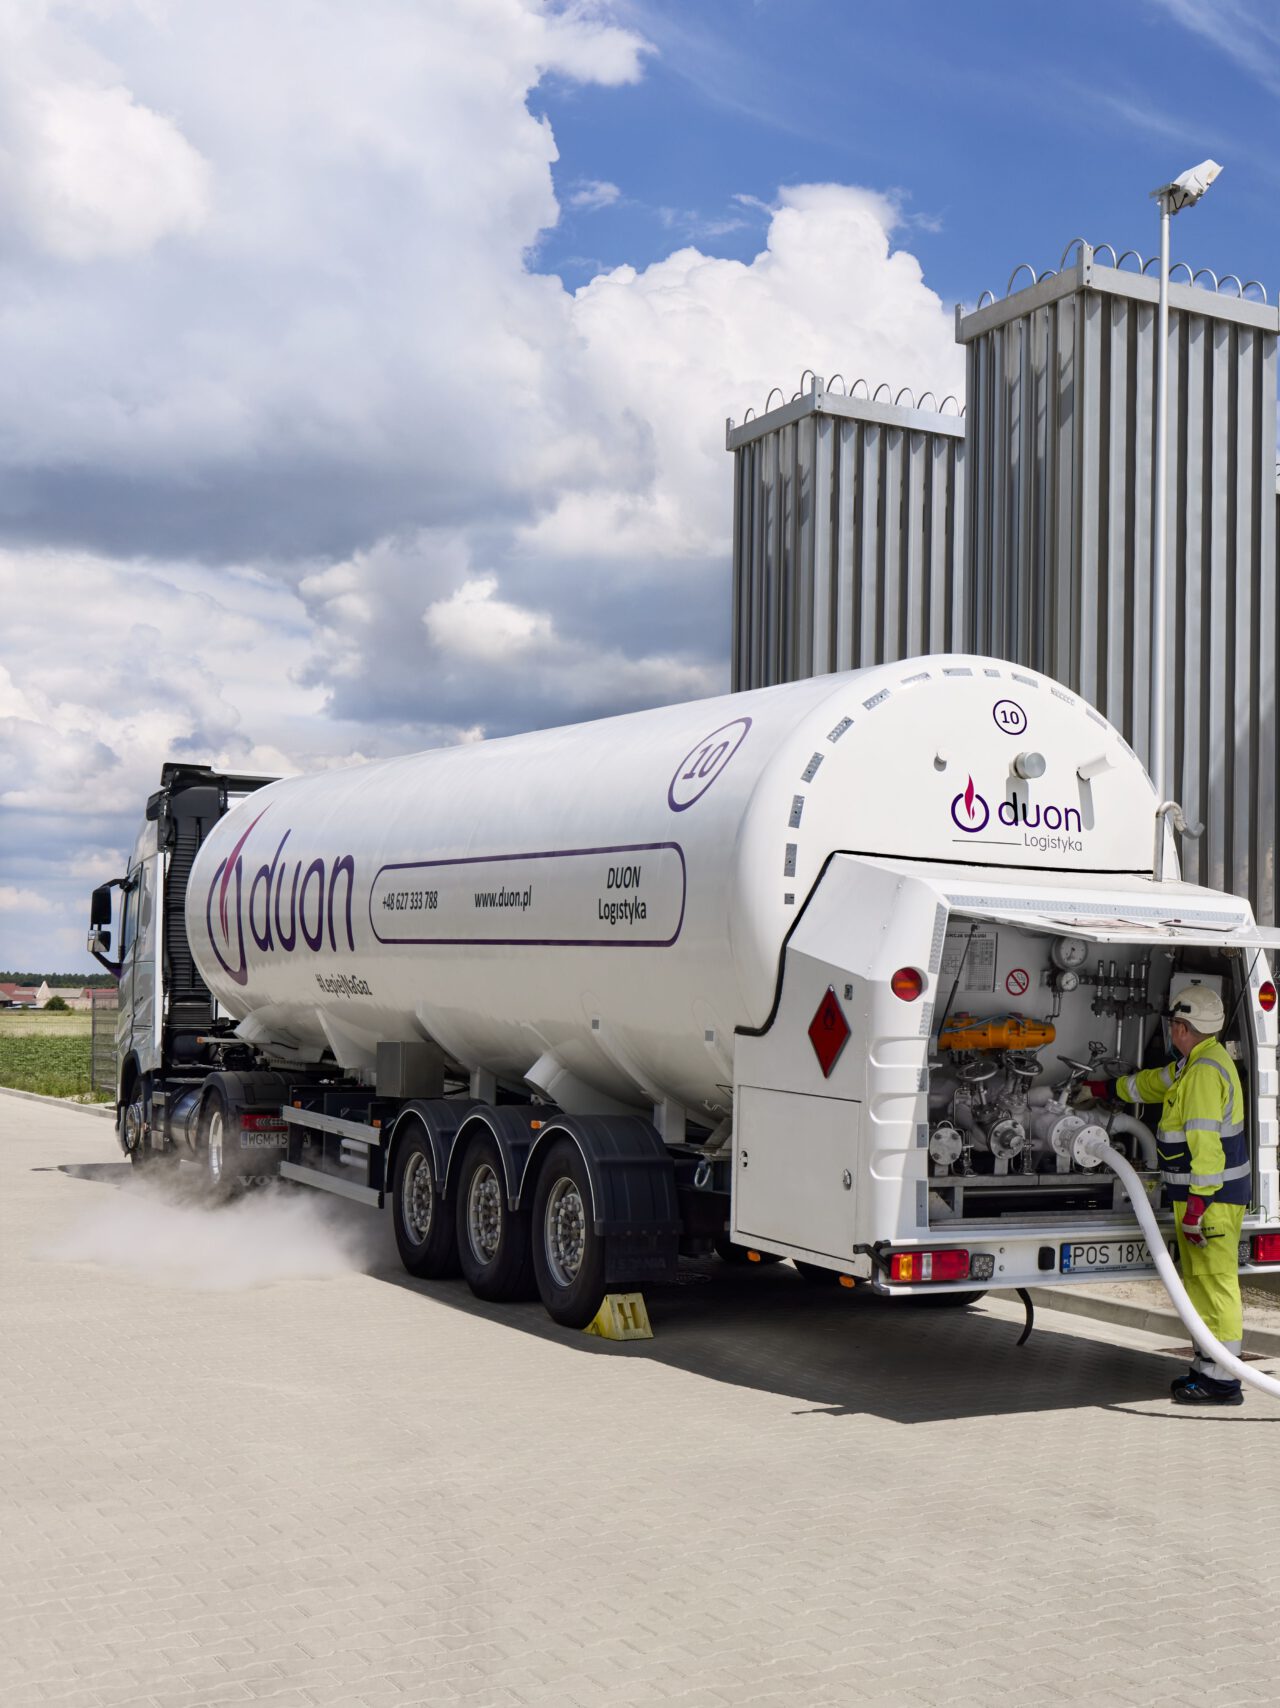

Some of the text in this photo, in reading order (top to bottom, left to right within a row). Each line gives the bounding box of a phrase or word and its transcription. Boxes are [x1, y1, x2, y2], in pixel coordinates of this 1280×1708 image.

[1000, 710, 1020, 725] 10
[682, 740, 730, 780] 10
[998, 791, 1082, 832] duon
[1024, 832, 1083, 853] Logistyka
[606, 866, 642, 889] DUON
[250, 828, 355, 952] duon
[382, 890, 438, 911] +48 627 333 788
[474, 885, 532, 912] www.duon.pl
[598, 896, 647, 925] Logistyka
[248, 1133, 271, 1145] WGM
[1072, 1245, 1110, 1266] POS
